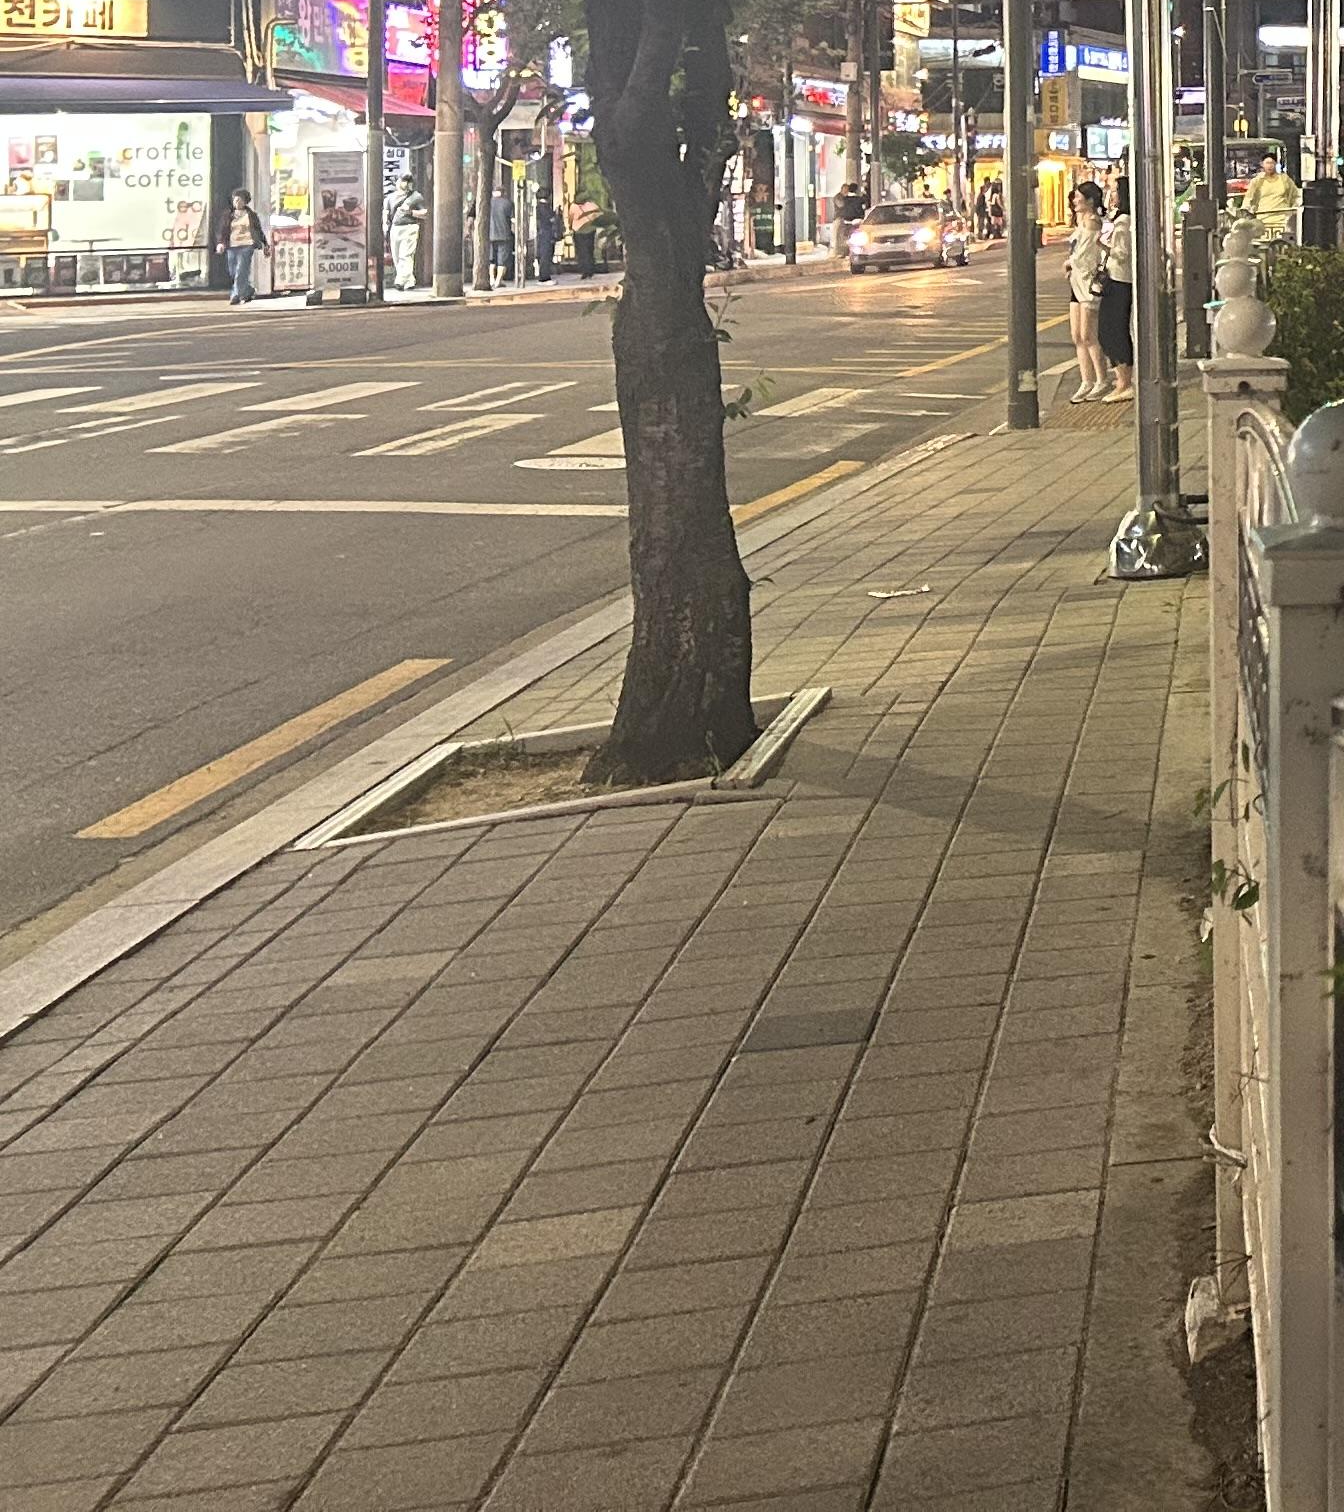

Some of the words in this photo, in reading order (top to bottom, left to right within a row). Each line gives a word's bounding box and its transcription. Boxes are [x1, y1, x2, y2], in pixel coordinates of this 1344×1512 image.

[122, 141, 204, 161] croffle
[125, 169, 204, 188] coffee
[165, 197, 203, 214] tea
